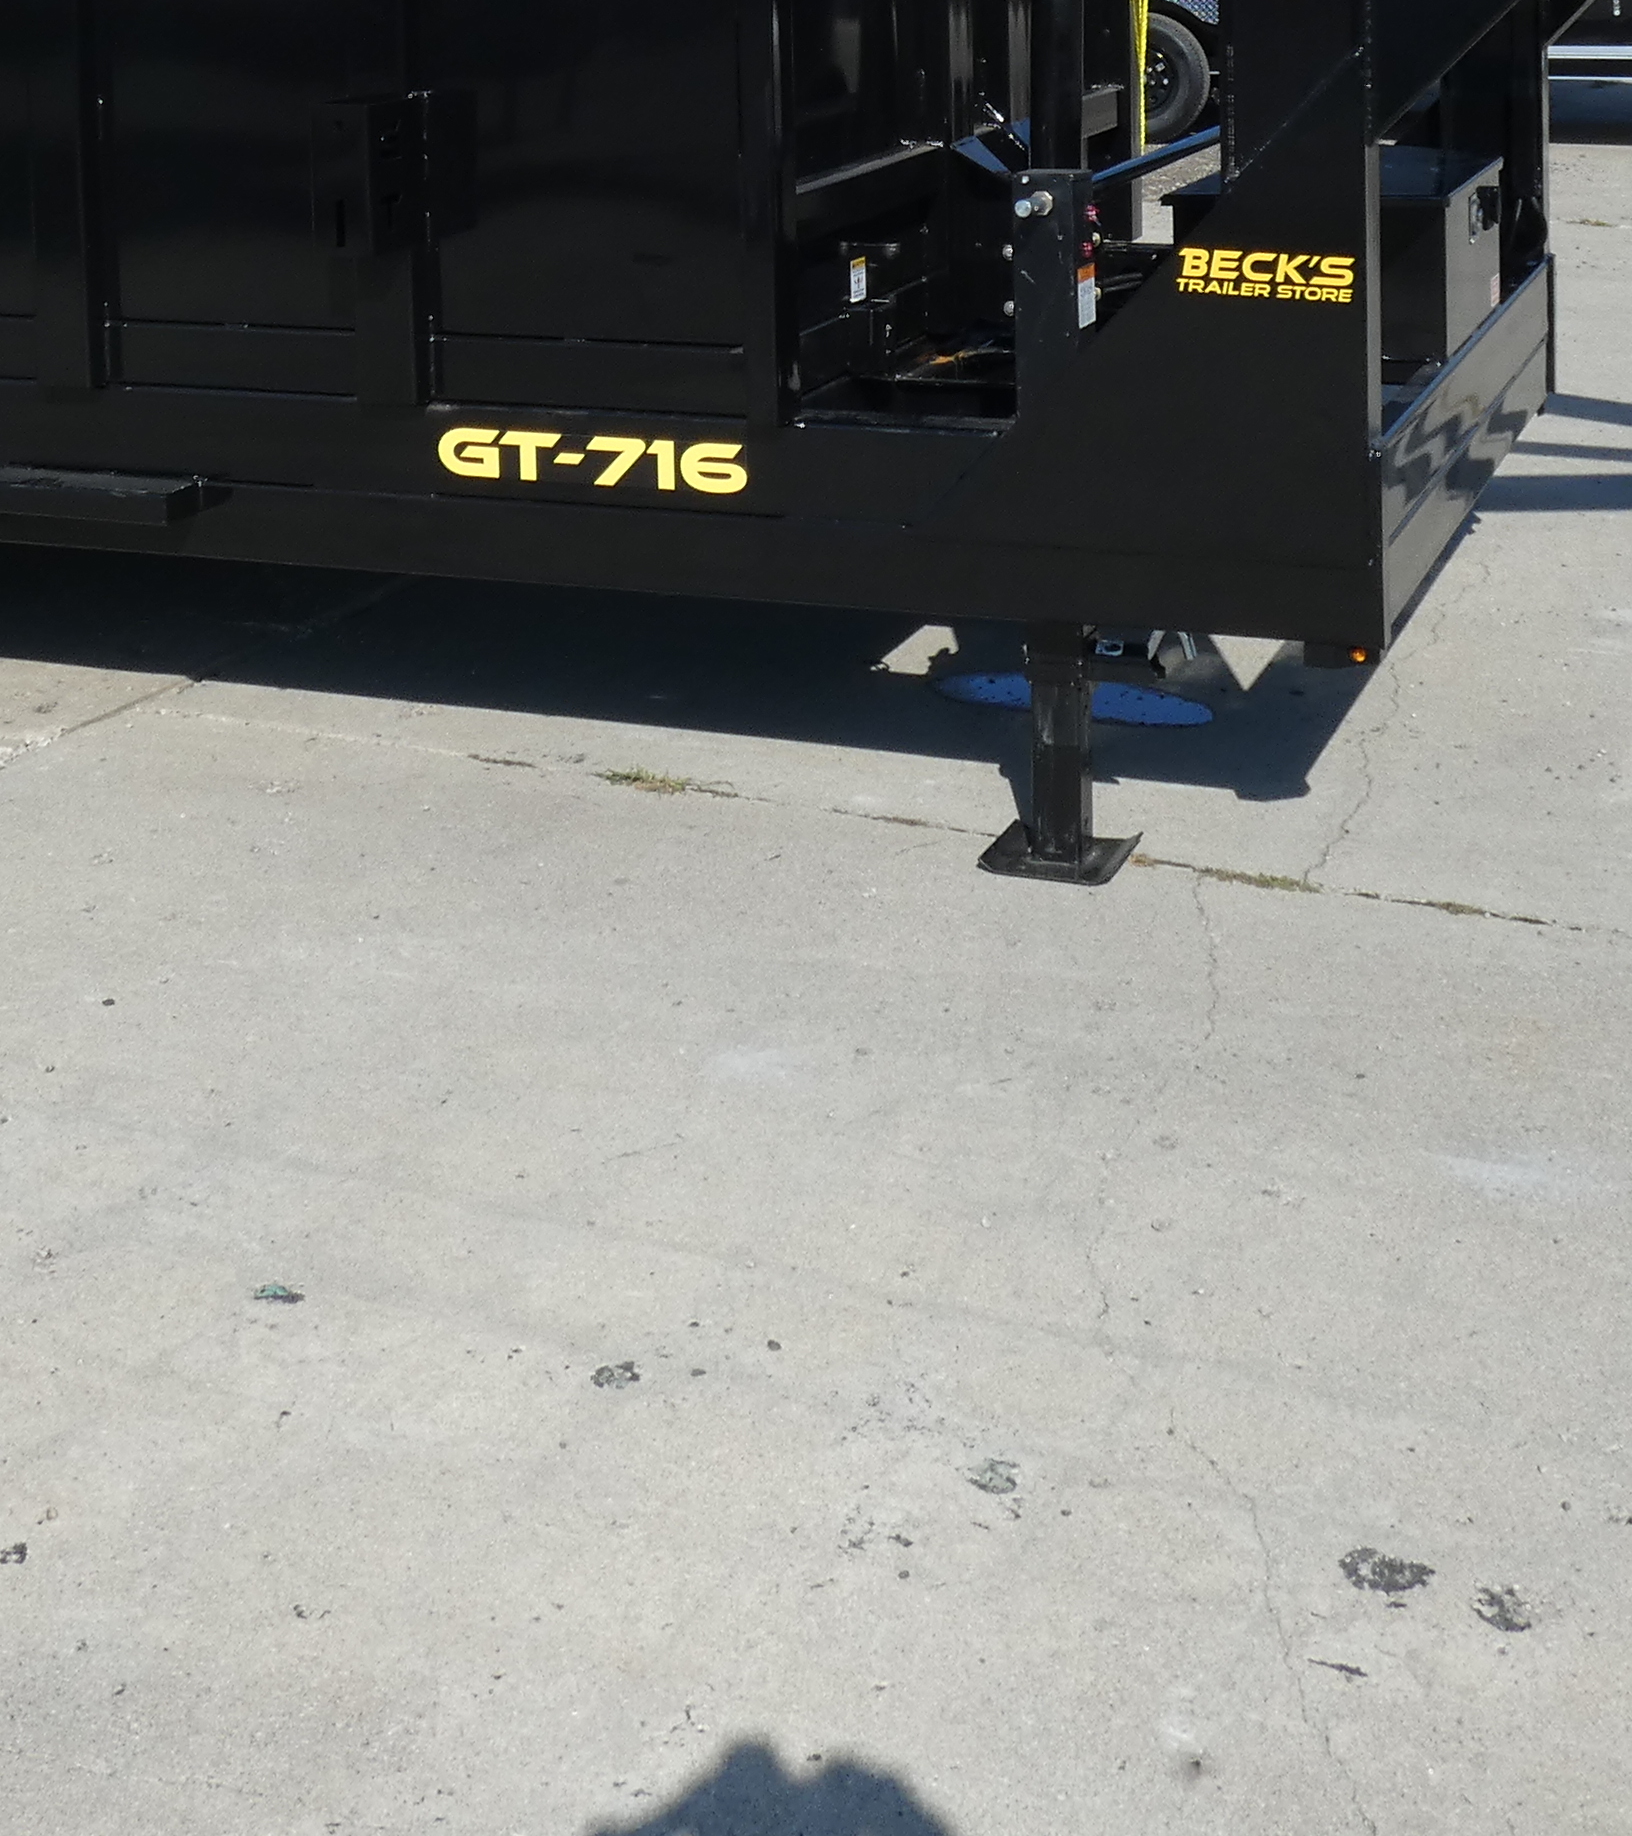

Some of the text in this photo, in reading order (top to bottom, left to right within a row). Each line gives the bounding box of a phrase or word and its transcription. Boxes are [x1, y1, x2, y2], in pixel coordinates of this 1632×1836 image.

[1178, 247, 1356, 287] BECK'S
[1176, 278, 1354, 304] TRAILER STORE
[437, 427, 748, 494] GT-716
